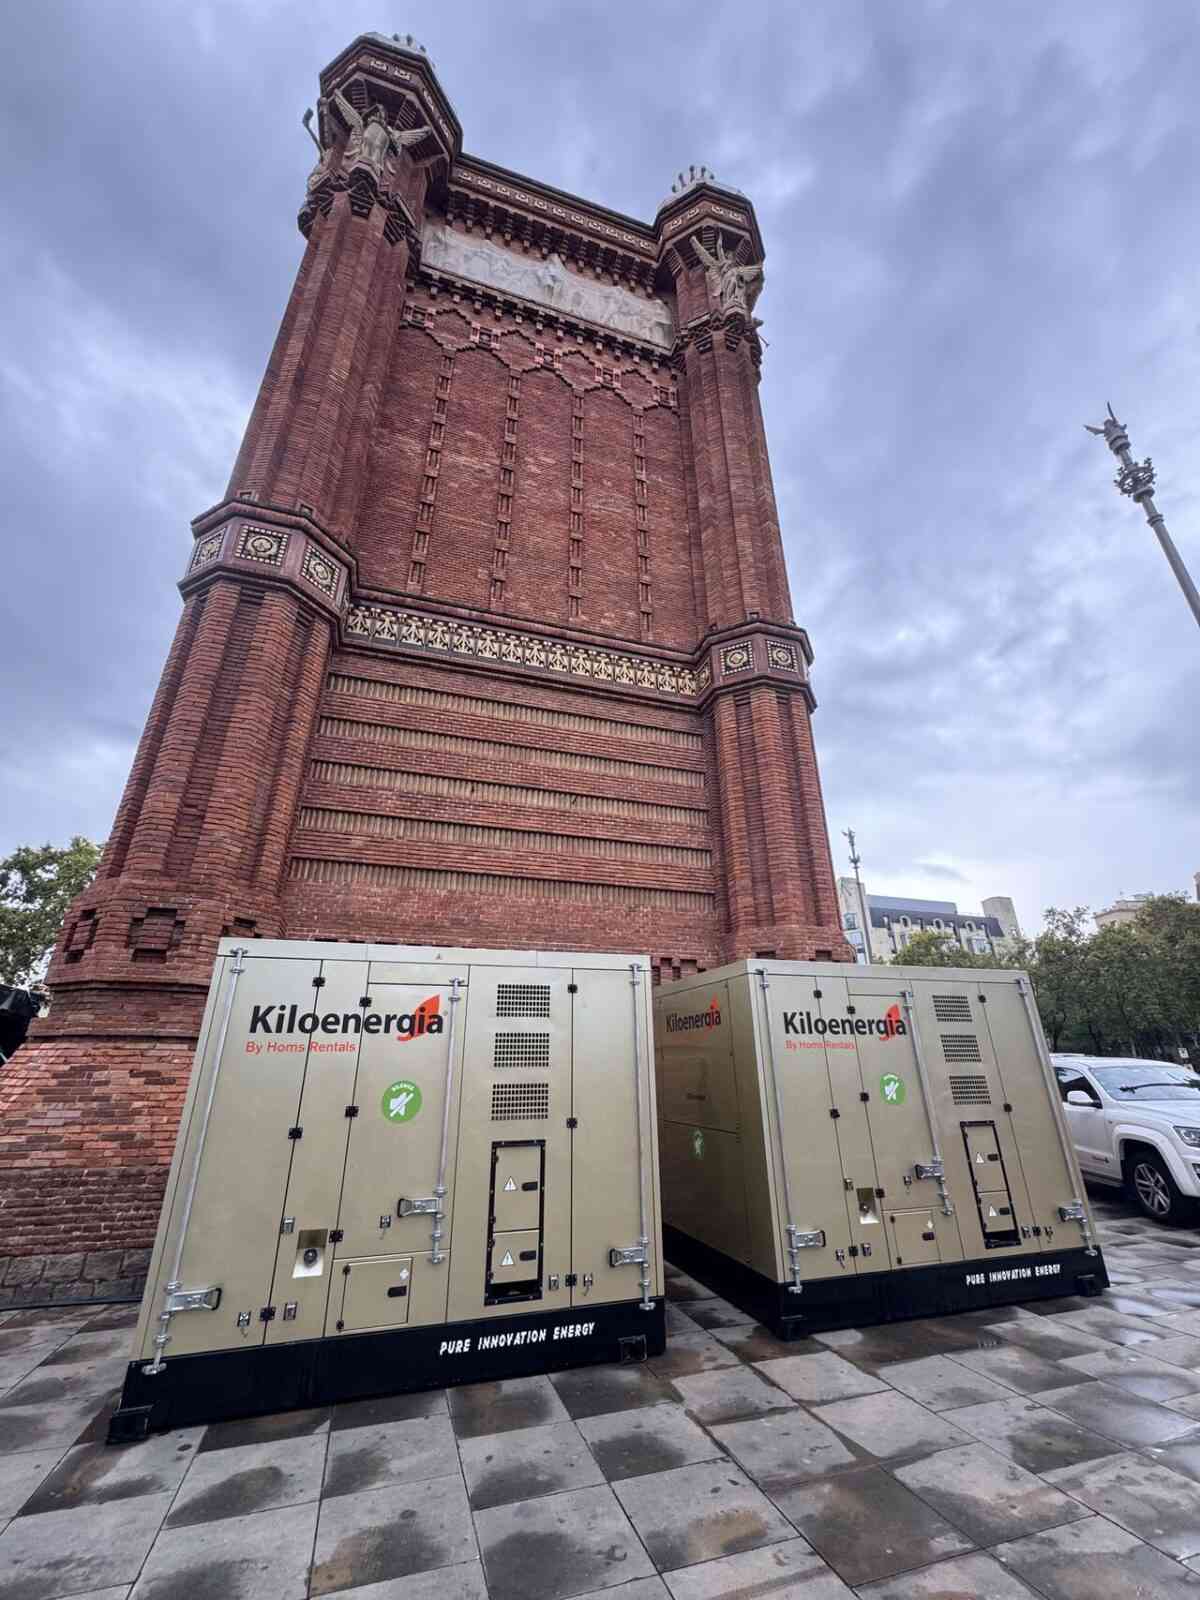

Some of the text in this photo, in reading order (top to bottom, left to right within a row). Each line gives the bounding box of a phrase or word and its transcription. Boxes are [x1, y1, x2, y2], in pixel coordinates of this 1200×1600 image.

[249, 1003, 444, 1041] Kiloenergia
[665, 1005, 722, 1033] Kiloenergia
[783, 1010, 907, 1041] Kiloenergia
[245, 1040, 357, 1054] By Homs Rentals
[966, 1263, 1060, 1286] PURE INNOVATION ENERGY
[439, 1321, 596, 1356] PURE INNOVATION ENERGY
